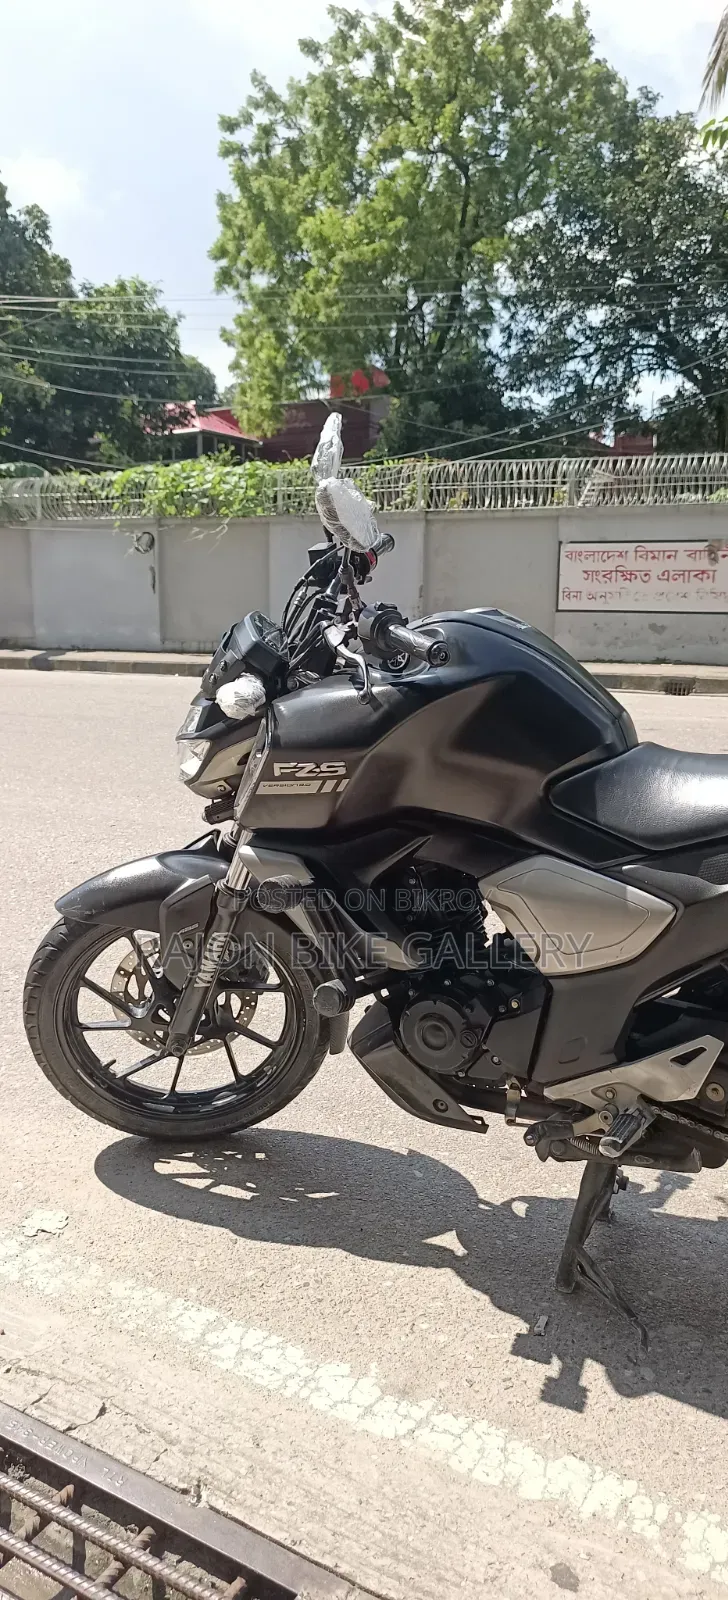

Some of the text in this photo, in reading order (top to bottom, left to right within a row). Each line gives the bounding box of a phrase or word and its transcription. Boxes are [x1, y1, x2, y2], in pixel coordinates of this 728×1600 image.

[565, 550, 628, 563] বাংলাদেশ
[634, 545, 678, 561] বিমান
[582, 565, 717, 584] সংরক্ষিত এলাকা
[562, 587, 582, 601] বিনা
[194, 932, 229, 988] YAMAHA
